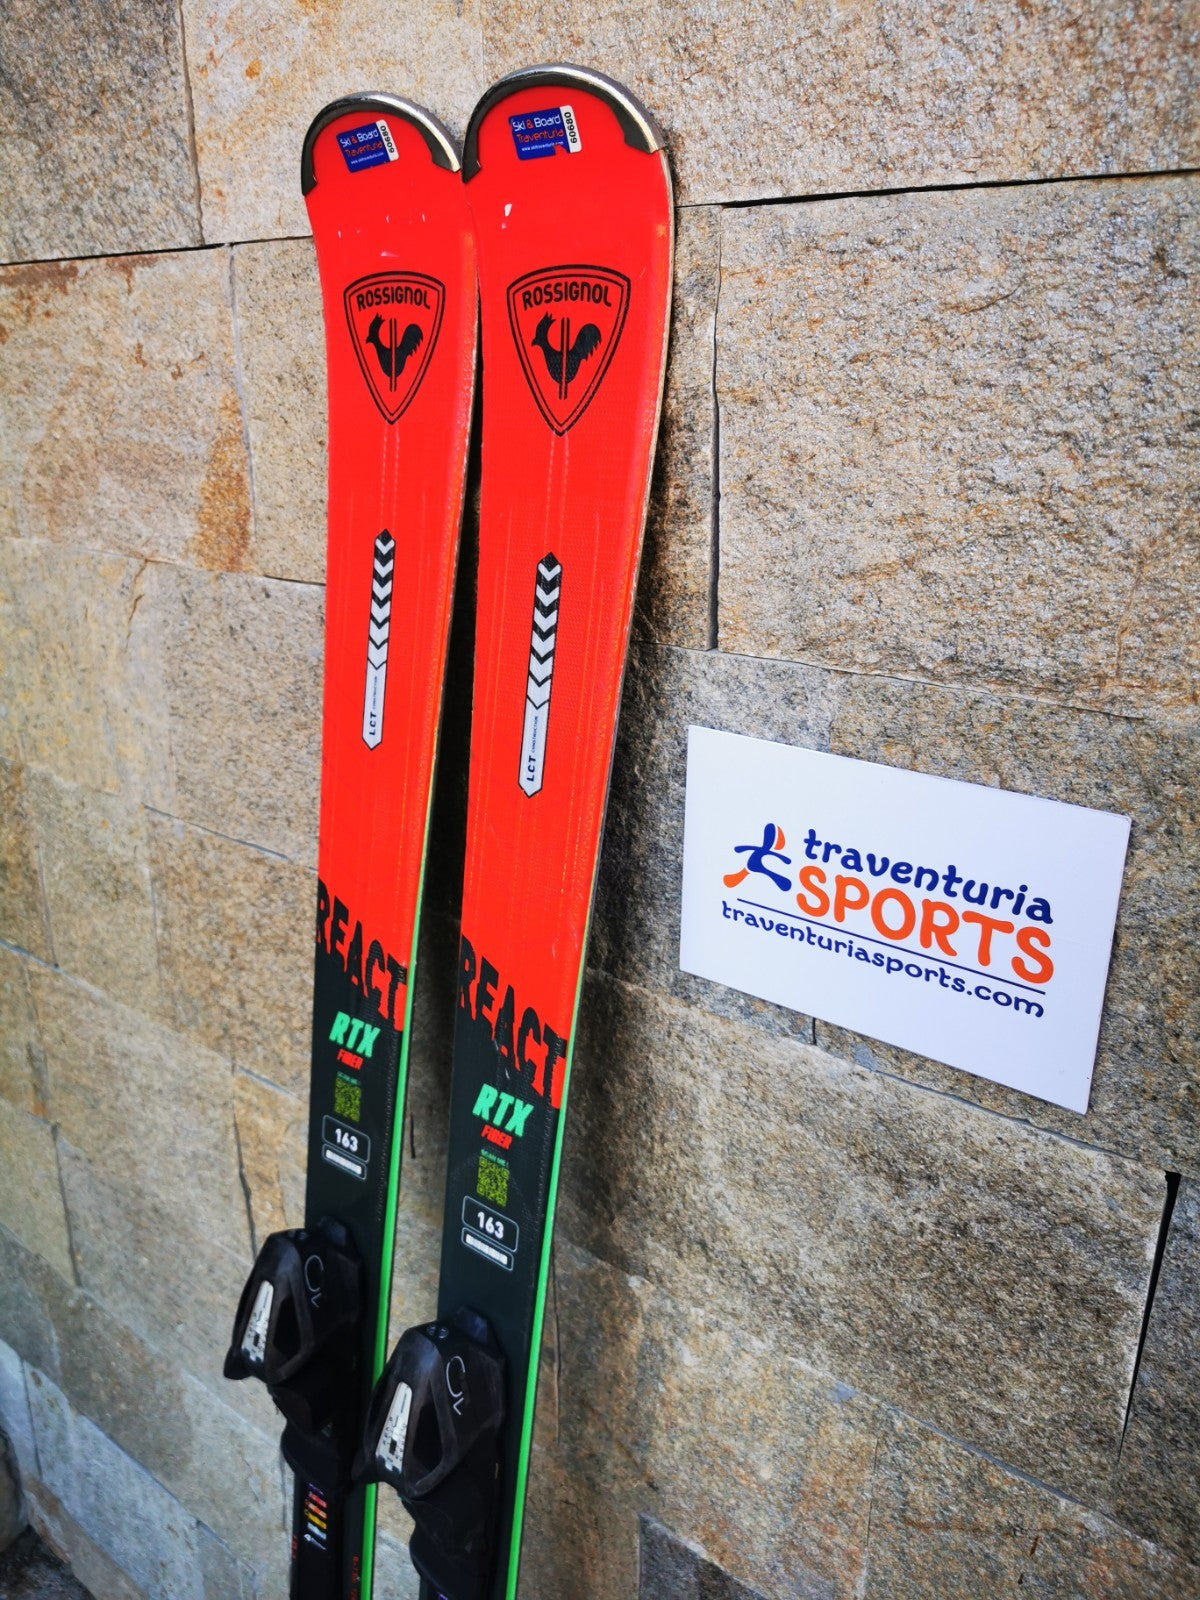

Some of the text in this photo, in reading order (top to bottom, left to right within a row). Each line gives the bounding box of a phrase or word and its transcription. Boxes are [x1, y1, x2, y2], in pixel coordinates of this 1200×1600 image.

[357, 128, 379, 142] Board
[512, 114, 561, 132] Ski & Board
[356, 286, 431, 311] ROSSIGNOL
[522, 281, 612, 310] ROSSIGNOL
[368, 711, 377, 736] LCT
[526, 755, 537, 782] LCT
[803, 829, 1054, 924] traventuria
[796, 866, 1055, 984] SPORTS
[315, 876, 408, 1028] REACT
[722, 900, 1045, 1018] traventuriasports.com
[457, 934, 568, 1105] REACT
[328, 1010, 381, 1059] RTX
[472, 1082, 535, 1138] RTX
[334, 1127, 359, 1153] 163
[477, 1210, 505, 1239] 163
